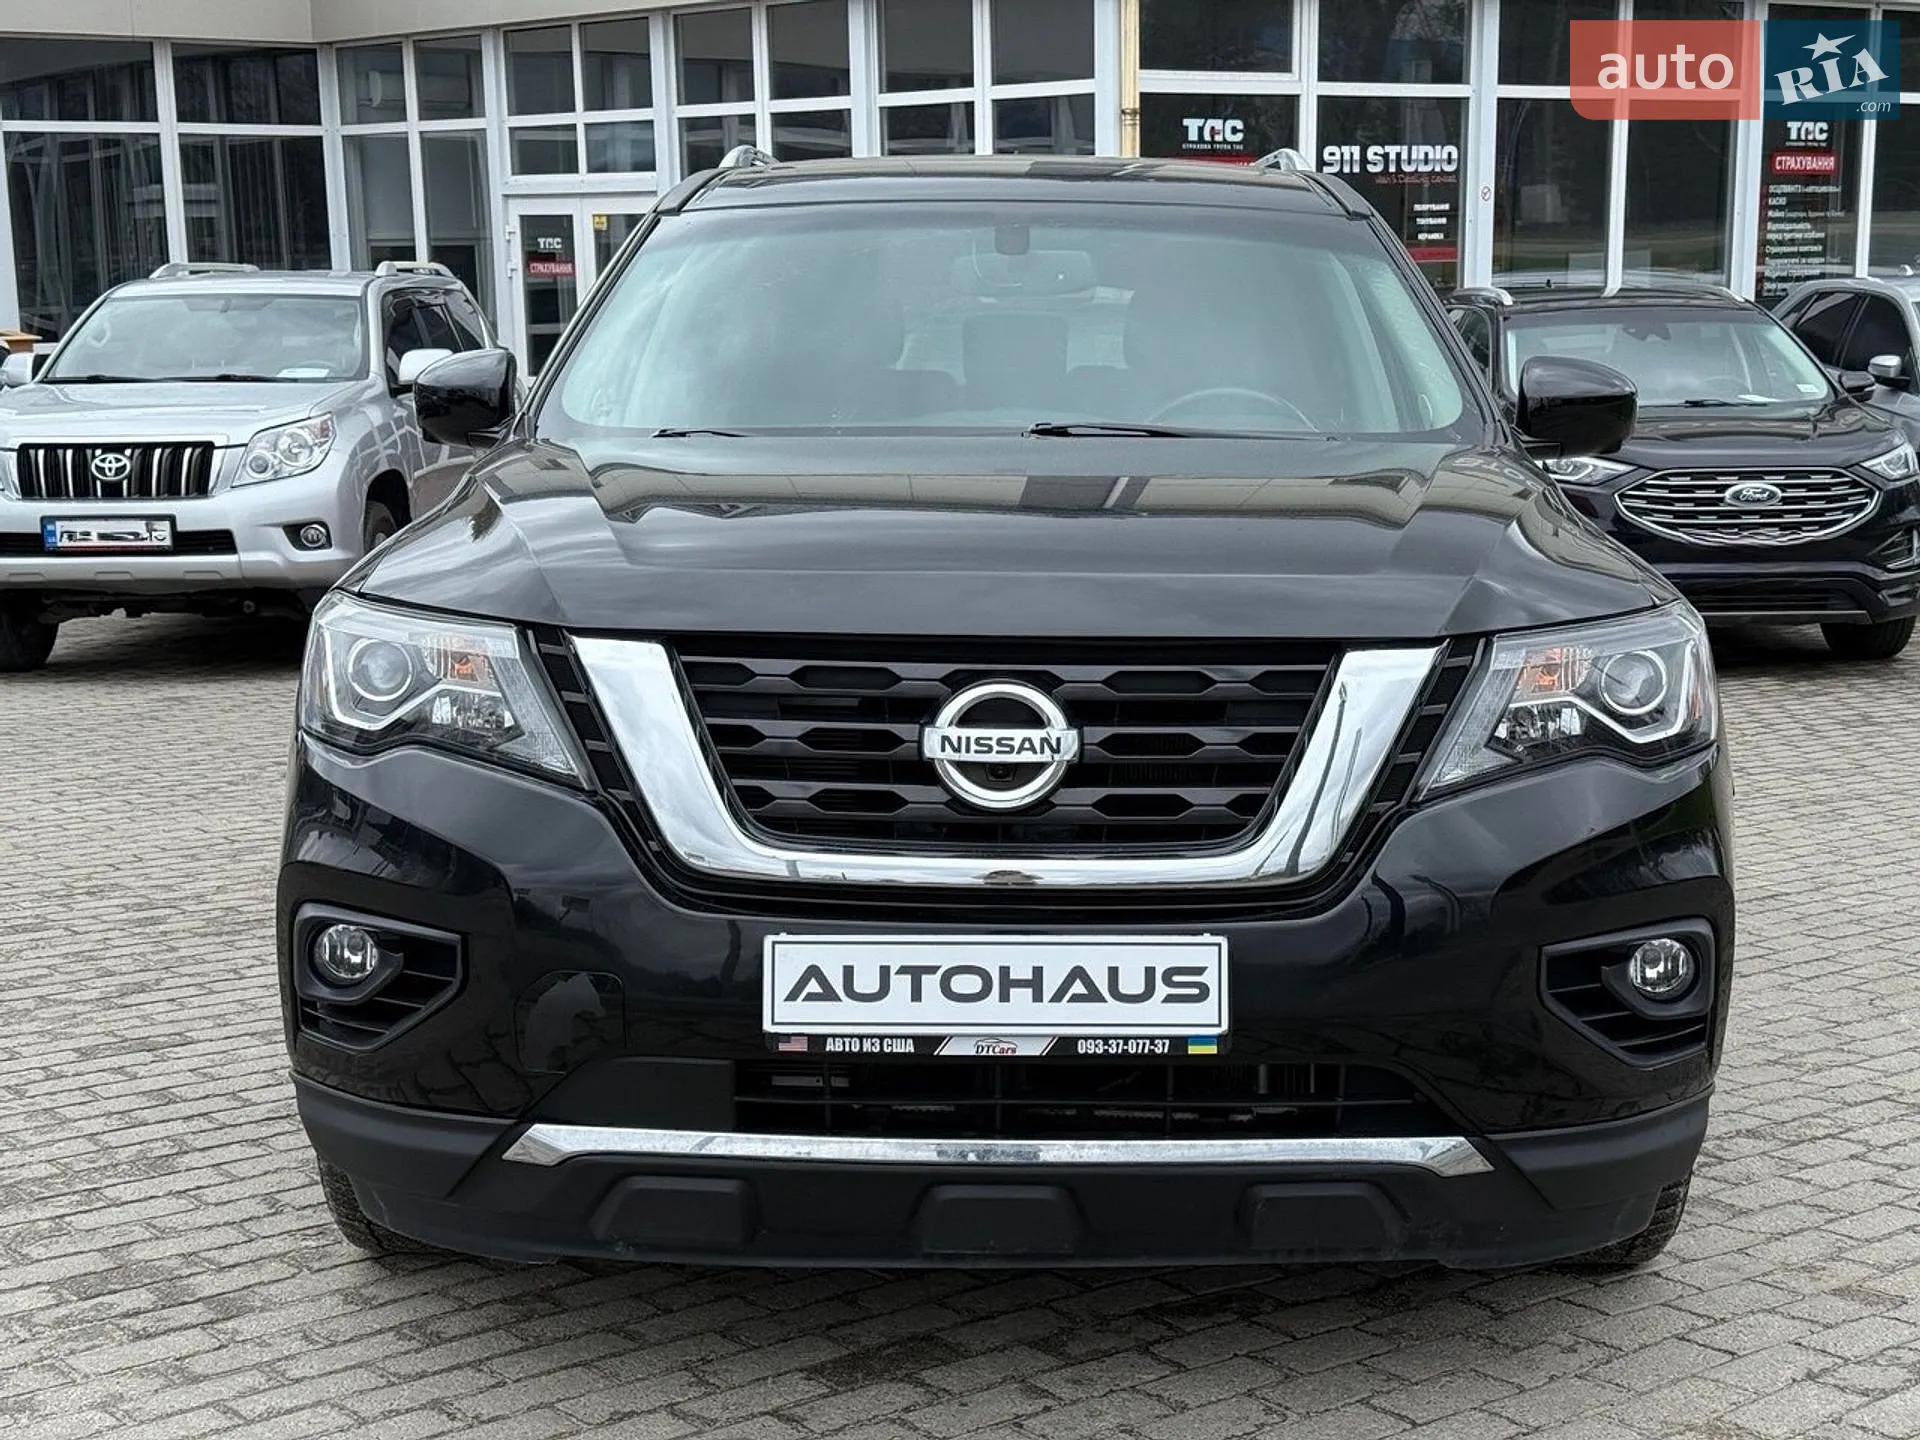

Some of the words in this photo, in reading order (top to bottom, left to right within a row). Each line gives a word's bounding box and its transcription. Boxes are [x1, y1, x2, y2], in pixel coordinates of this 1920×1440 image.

[1322, 145, 1360, 174] 911
[1366, 145, 1459, 174] STUDIO
[1775, 156, 1835, 171] СТРАХУВАННЯ
[940, 735, 1062, 755] NISSAN
[783, 964, 1211, 1004] AUTOHAUS
[825, 1037, 860, 1053] АВТО
[862, 1037, 882, 1053] ИЗ
[885, 1037, 915, 1053] США
[1077, 1039, 1170, 1055] 093-37-077-37
